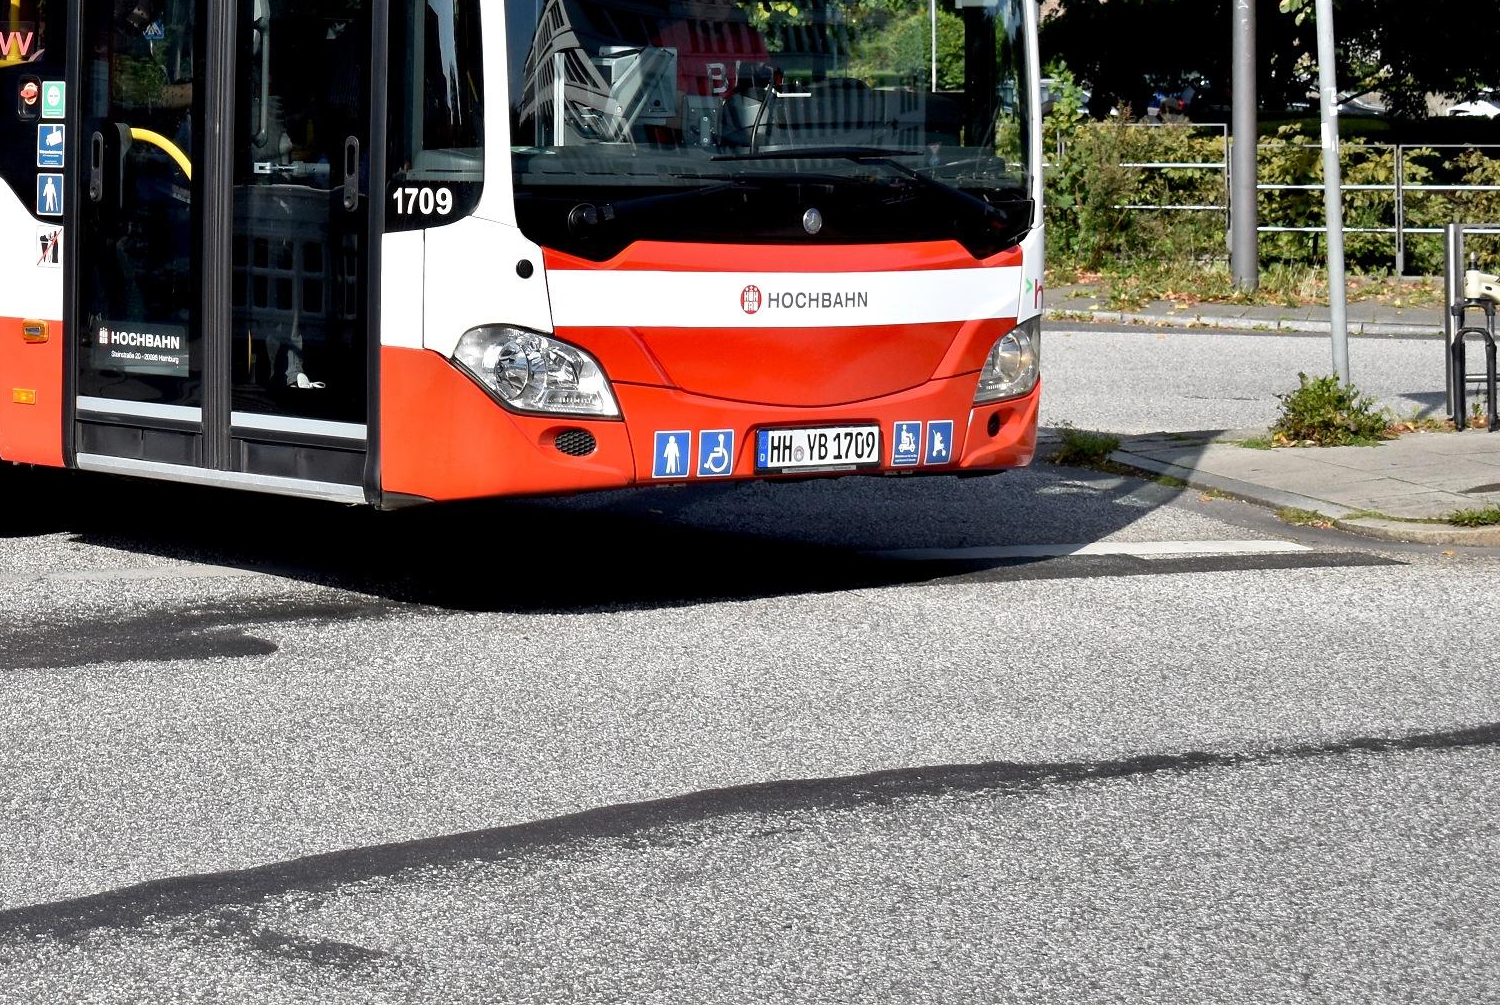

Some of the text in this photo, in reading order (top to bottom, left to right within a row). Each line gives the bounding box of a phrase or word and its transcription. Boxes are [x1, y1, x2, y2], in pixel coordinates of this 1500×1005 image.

[393, 187, 453, 215] 1709
[768, 291, 868, 309] HOCHBAHN
[111, 330, 180, 350] HOCHBAHN
[770, 431, 876, 463] HH YB 1709
